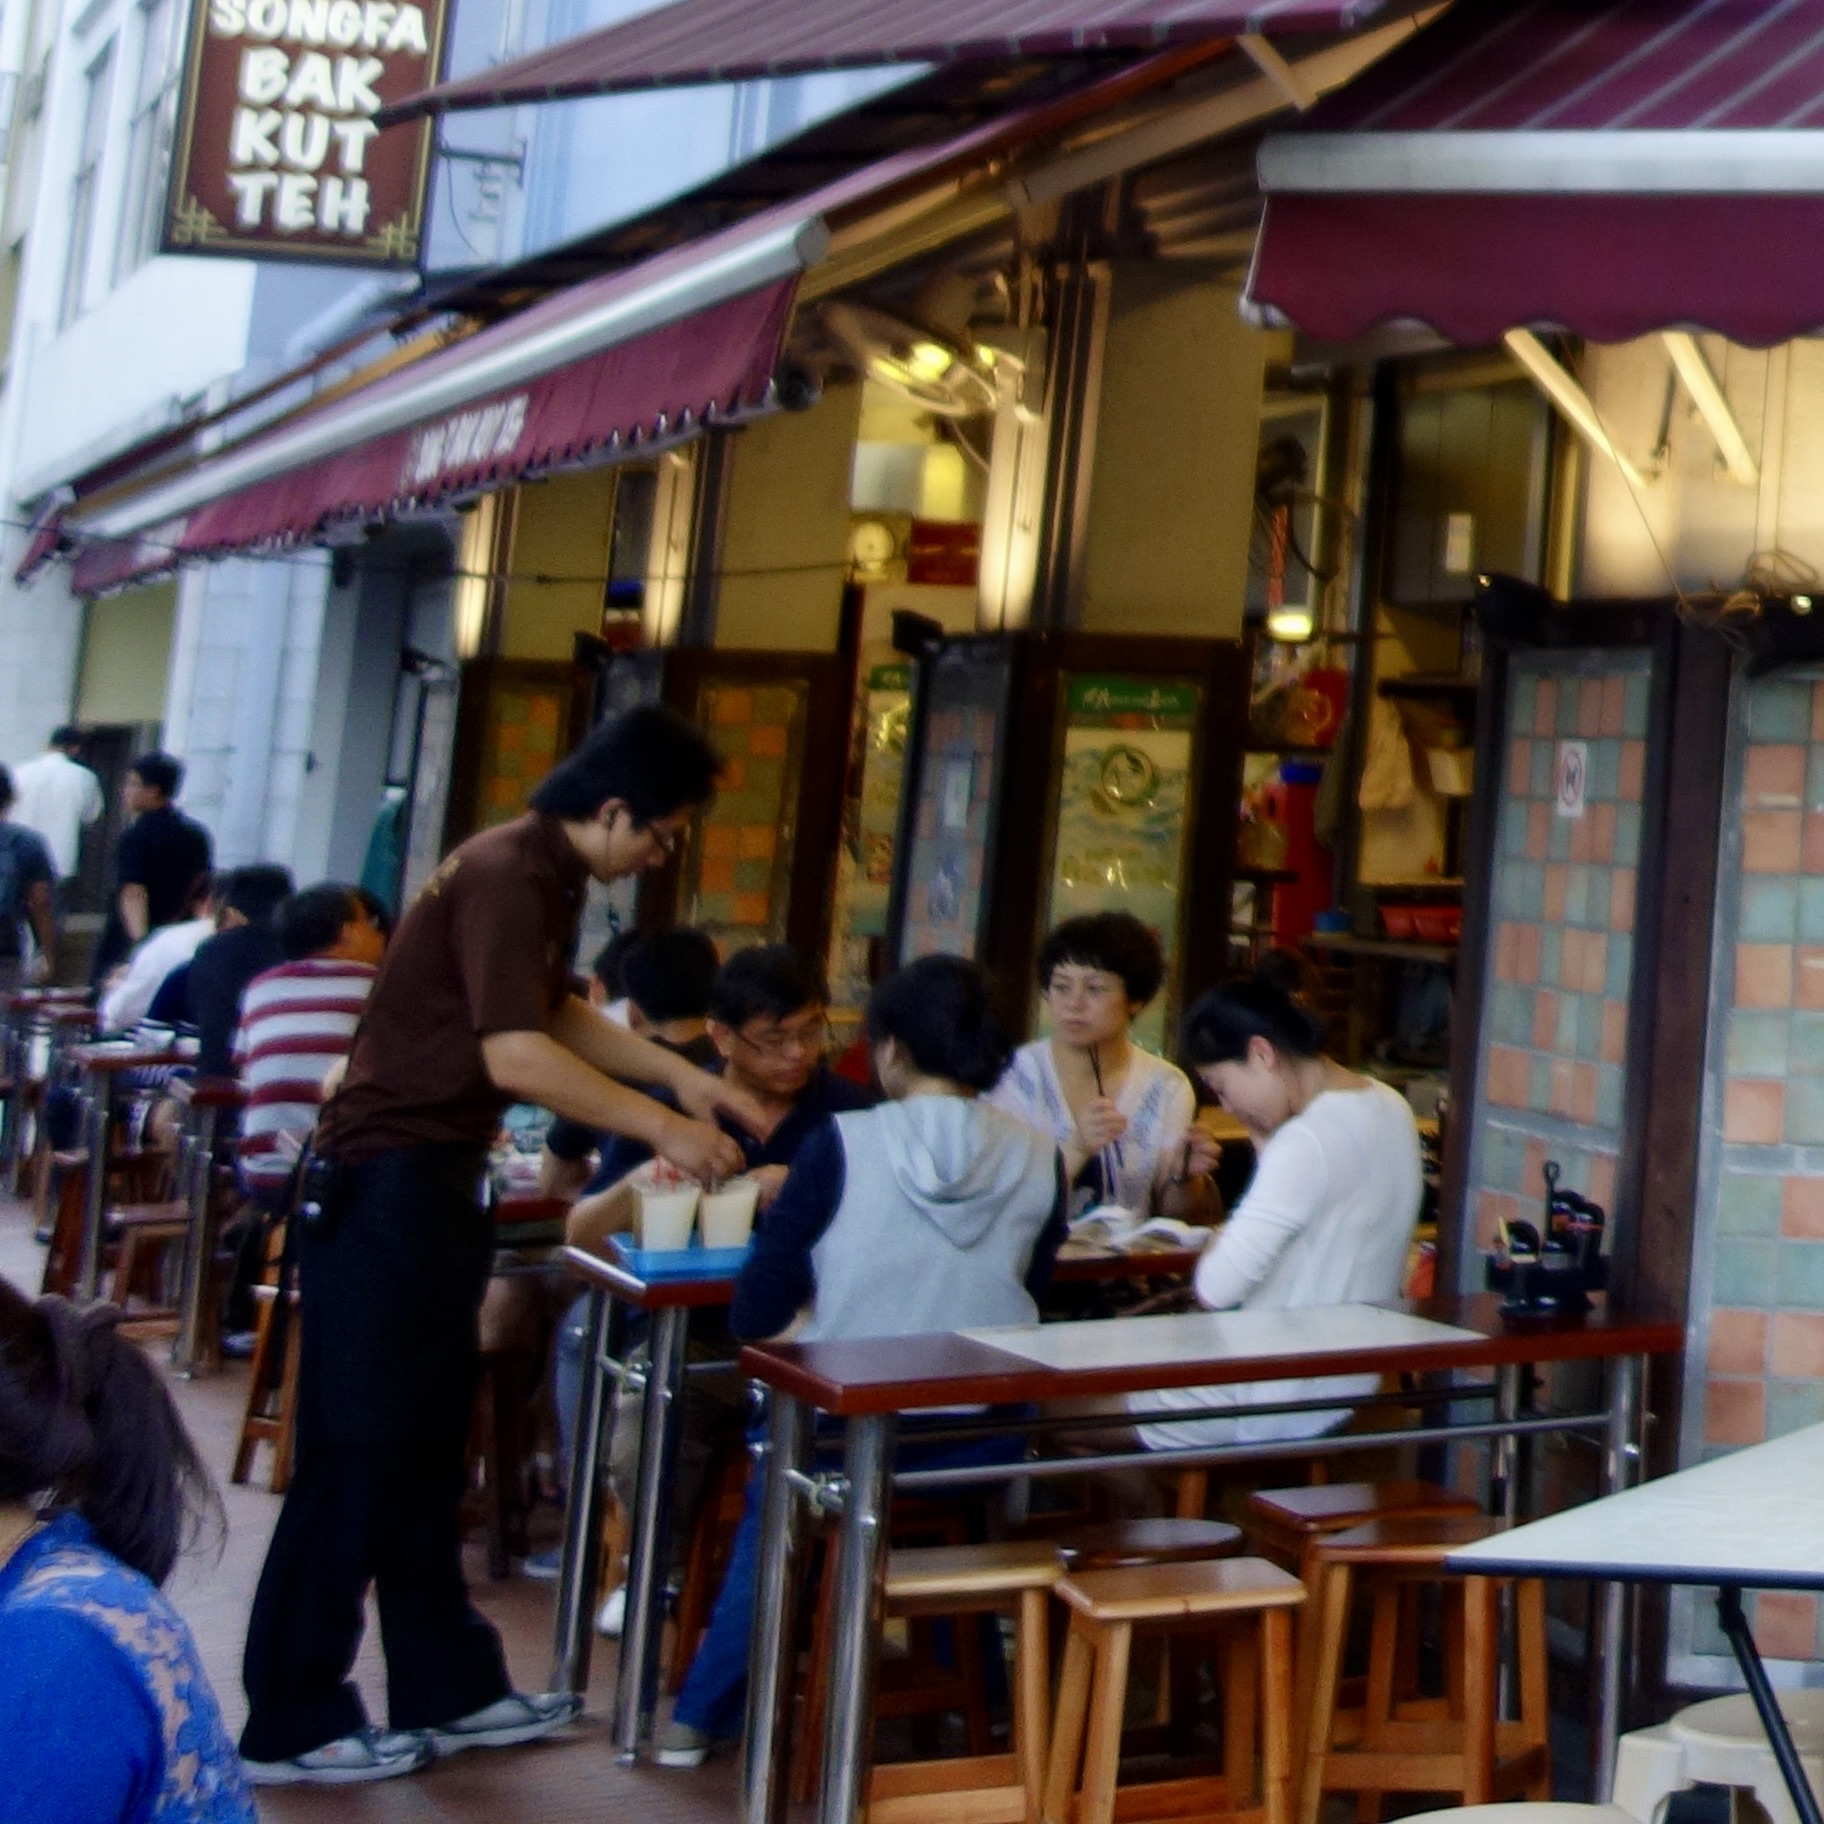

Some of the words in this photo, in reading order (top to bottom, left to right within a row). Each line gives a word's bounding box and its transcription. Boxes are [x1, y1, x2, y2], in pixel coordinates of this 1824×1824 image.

[239, 45, 384, 114] BAK
[229, 108, 380, 174] KUT
[226, 171, 370, 236] TEH
